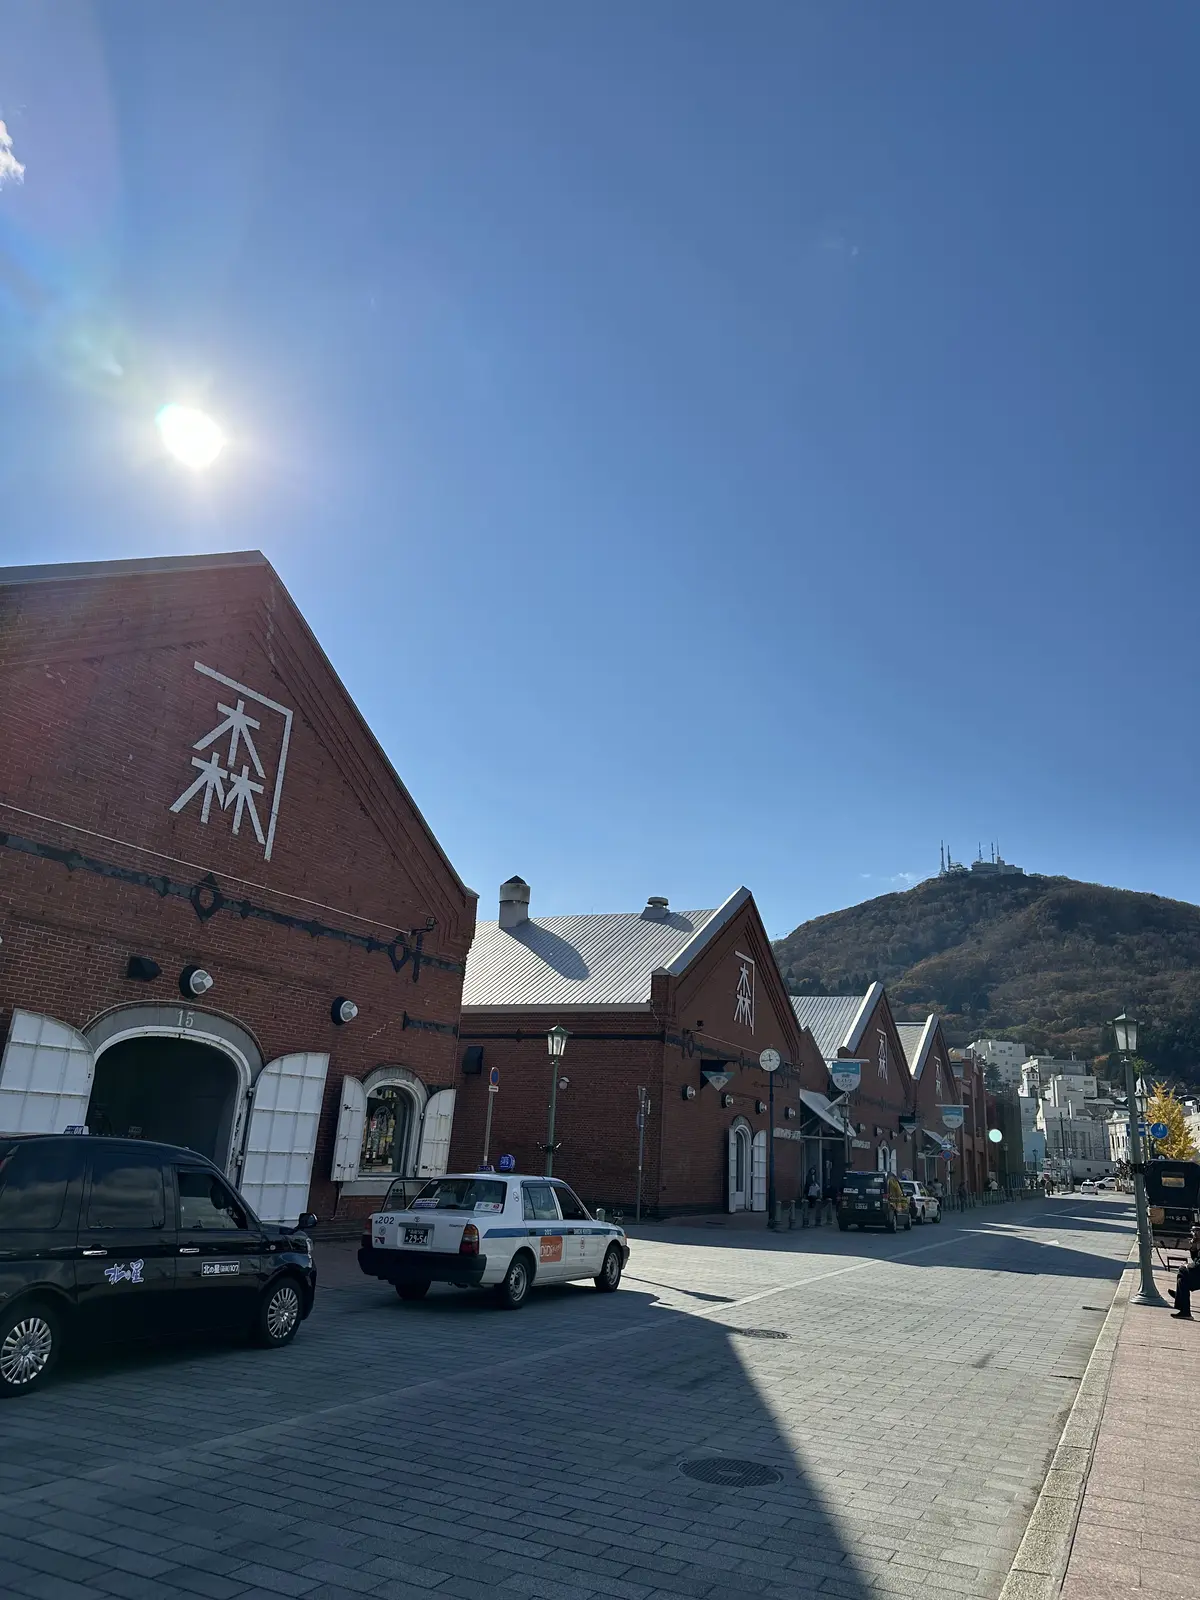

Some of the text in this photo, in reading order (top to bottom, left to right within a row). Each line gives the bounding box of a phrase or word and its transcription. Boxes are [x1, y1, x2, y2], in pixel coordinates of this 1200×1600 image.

[177, 1010, 195, 1028] 15
[378, 1215, 395, 1225] 202
[104, 1258, 145, 1285] 北の星
